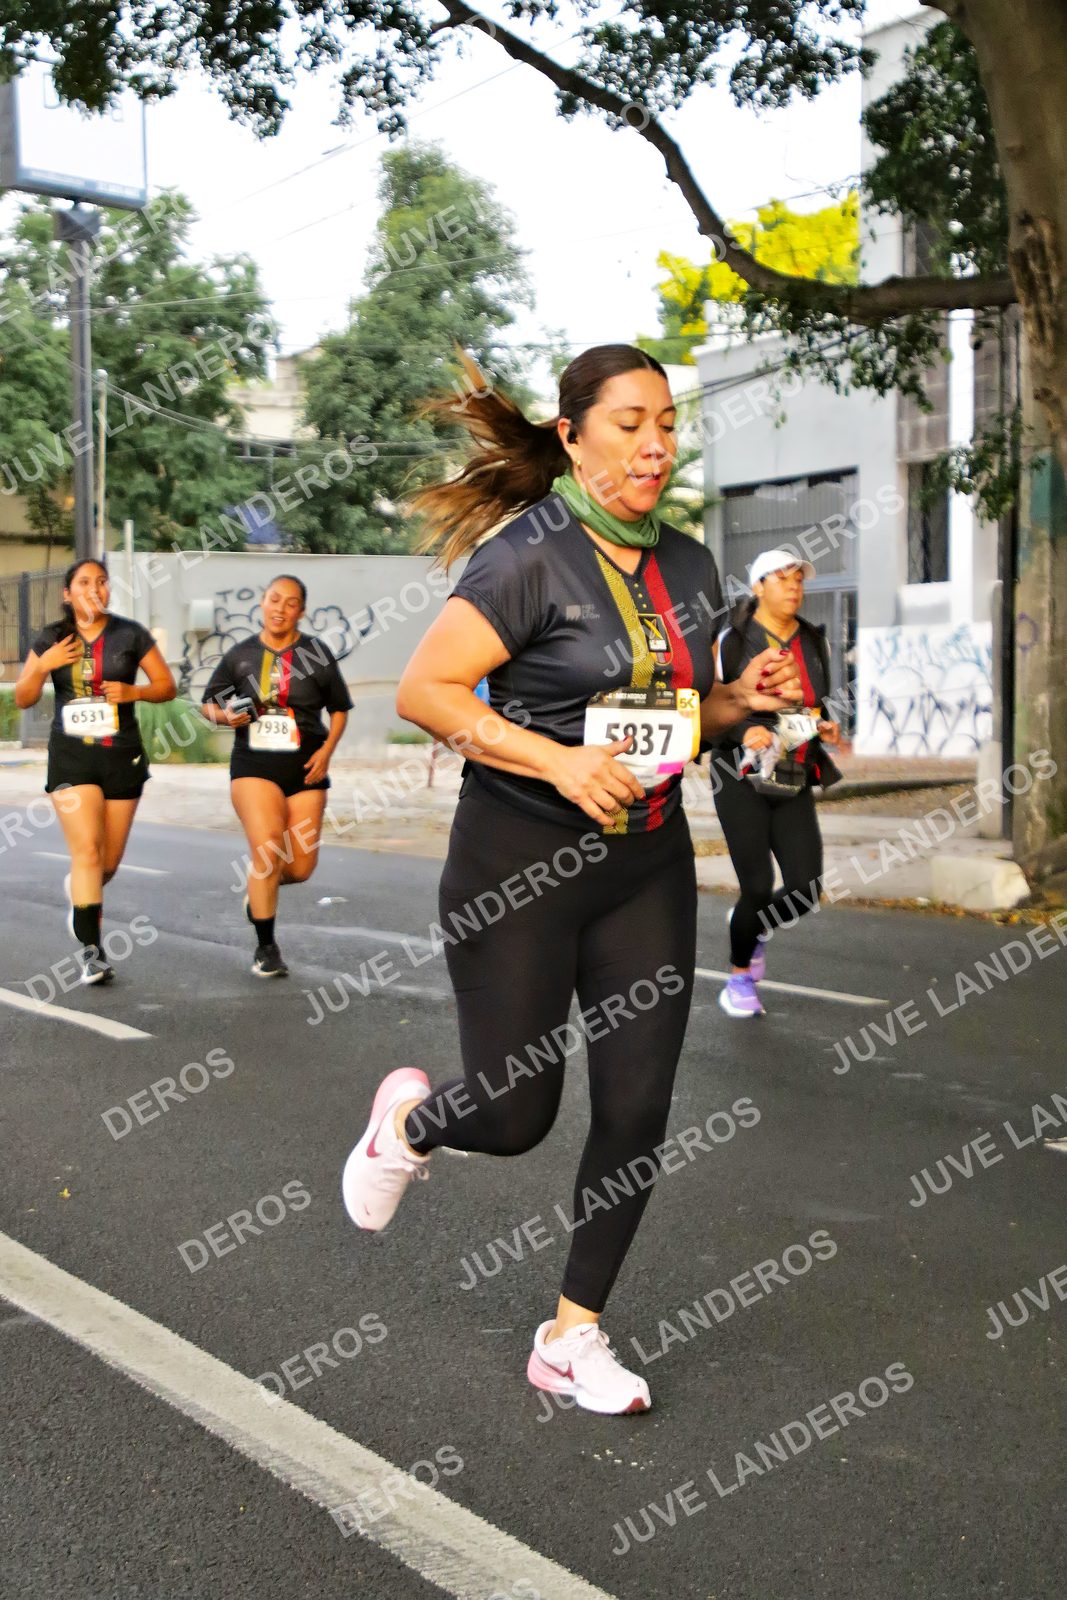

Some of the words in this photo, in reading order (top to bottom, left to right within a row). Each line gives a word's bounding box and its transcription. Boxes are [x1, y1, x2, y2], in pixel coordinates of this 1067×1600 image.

[216, 585, 265, 603] TO
[679, 698, 695, 709] 5K
[71, 710, 105, 724] 6531
[256, 720, 289, 735] 7938
[605, 722, 674, 756] 5837
